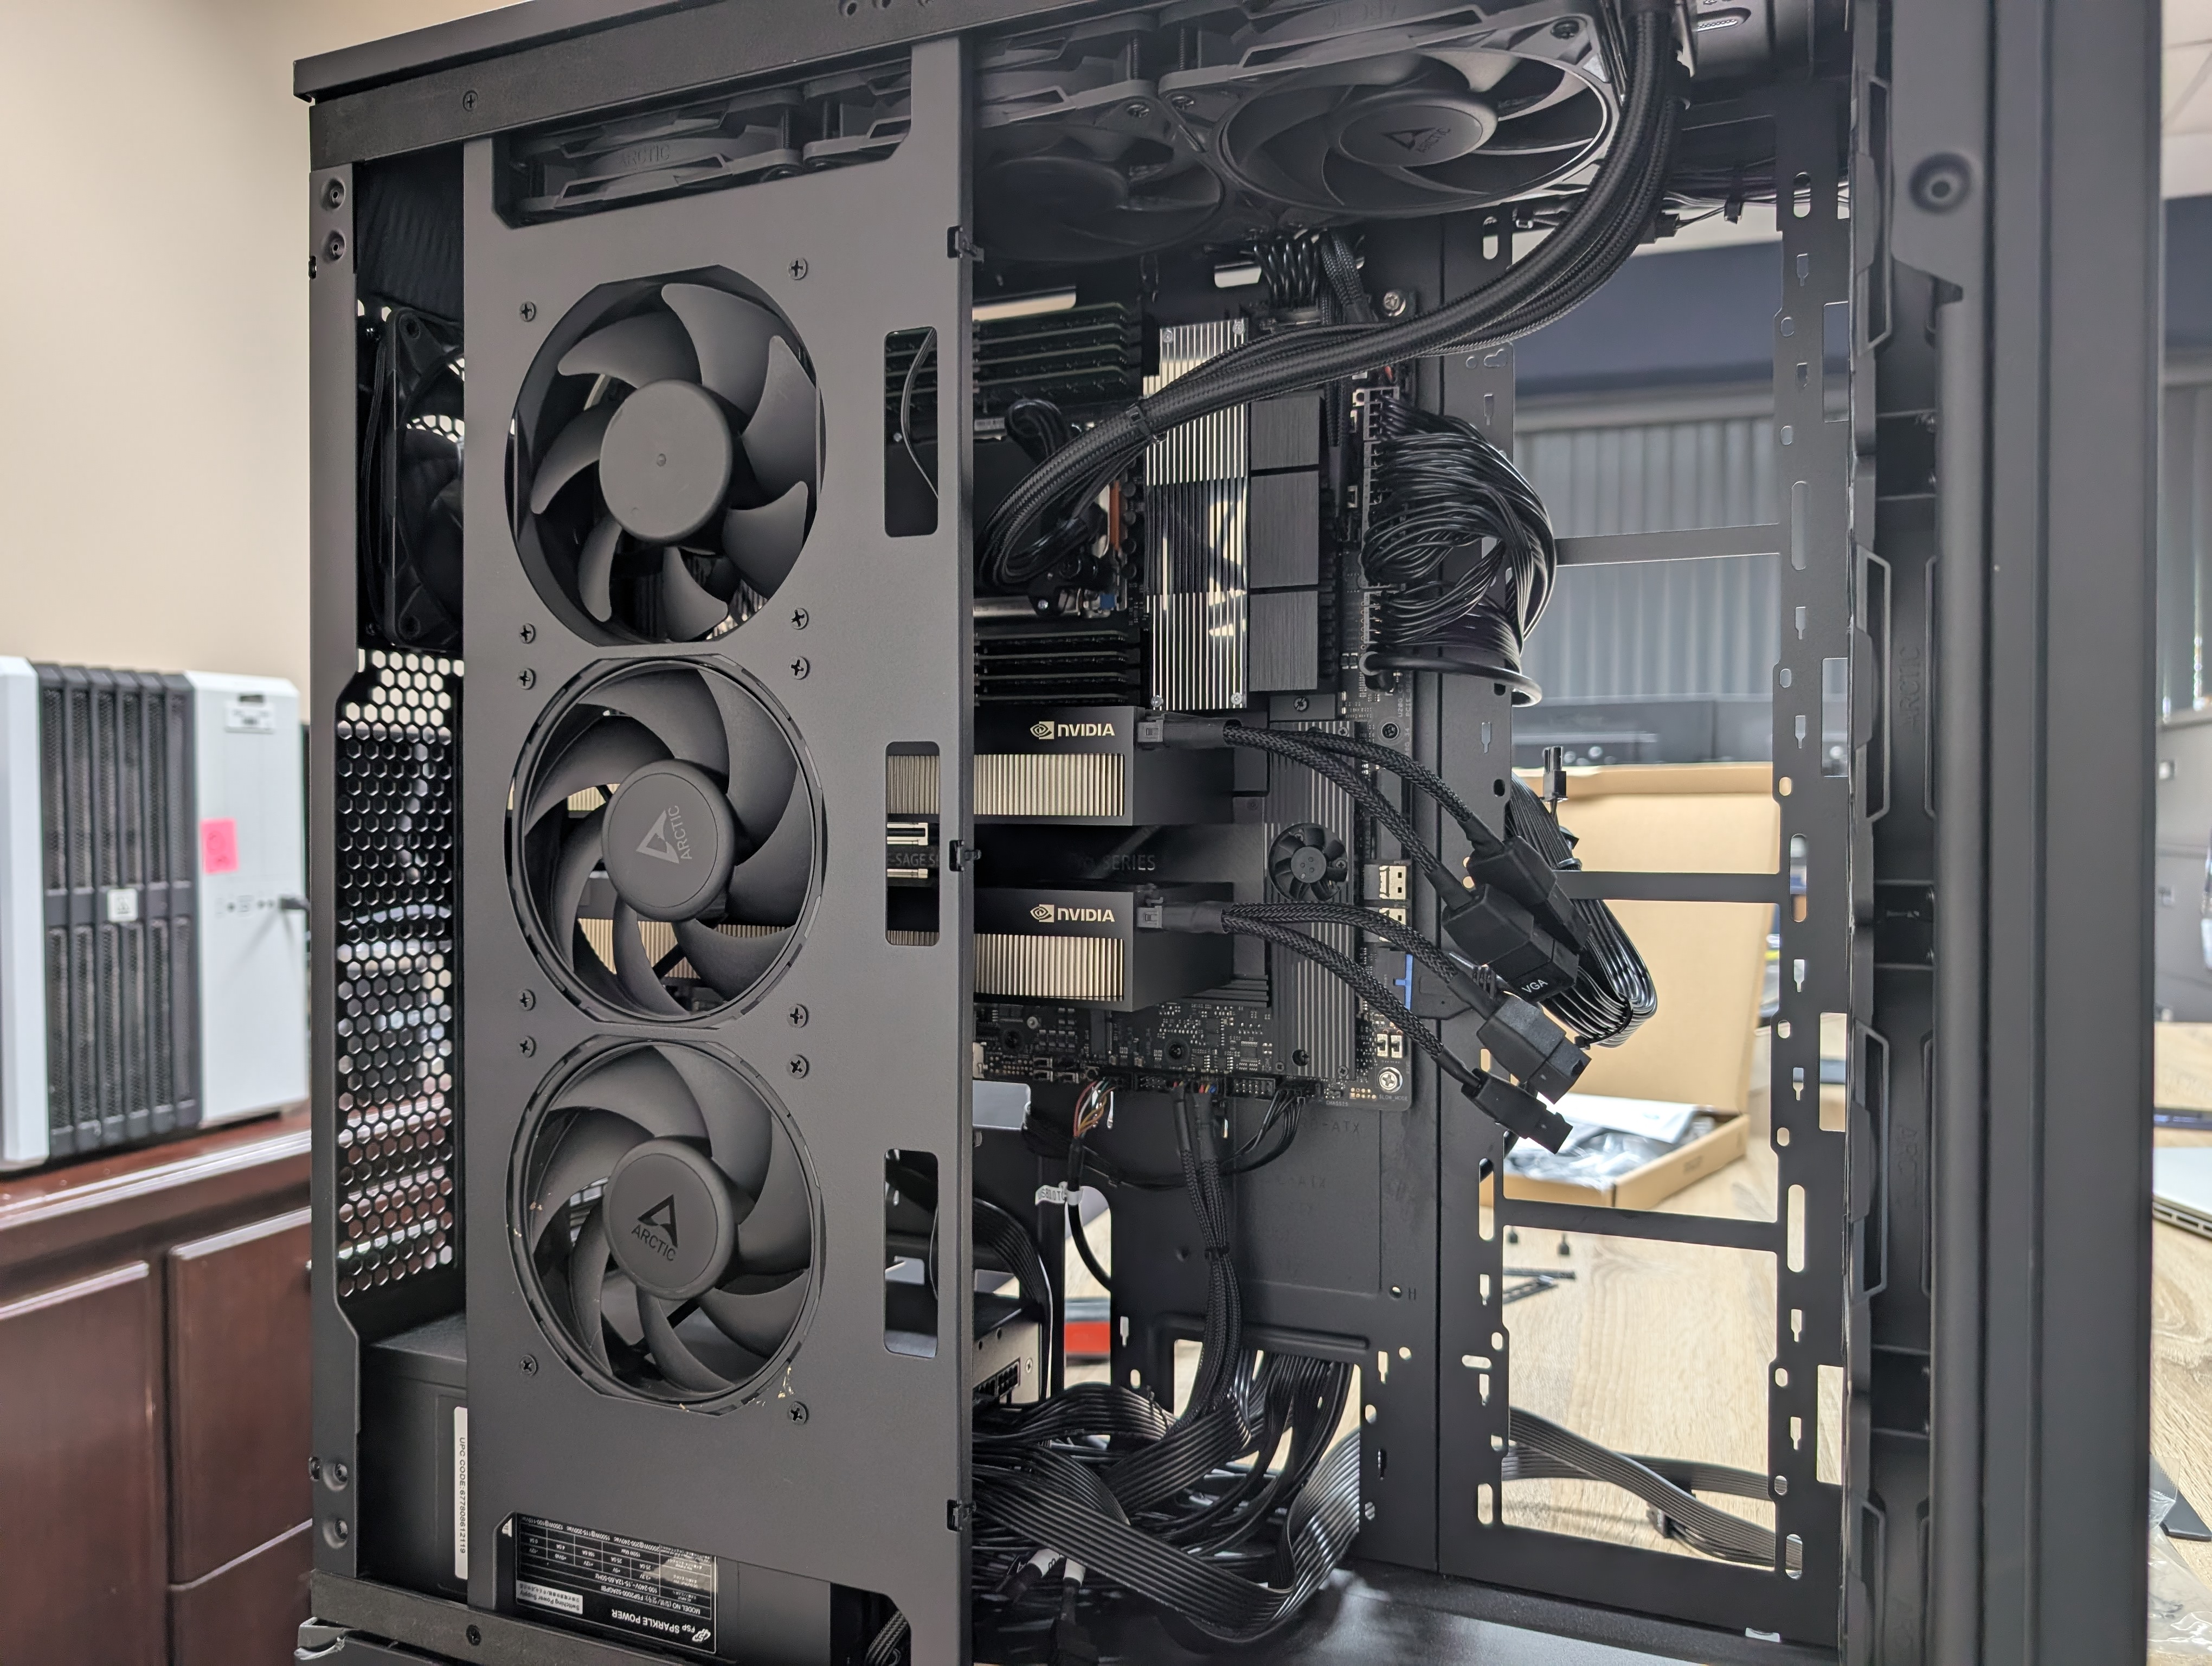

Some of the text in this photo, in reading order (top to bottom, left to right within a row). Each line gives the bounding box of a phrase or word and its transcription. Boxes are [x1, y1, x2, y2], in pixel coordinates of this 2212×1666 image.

[1058, 723, 1115, 736] NVIDIA
[668, 805, 692, 860] ARCTIC
[1103, 854, 1156, 872] SERIES
[1057, 908, 1115, 922] NVIDIA
[1521, 979, 1548, 992] VGA
[631, 1225, 676, 1261] ARCTIC
[538, 1594, 554, 1604] Power
[555, 1598, 580, 1611] Switching
[612, 1609, 641, 1624] POWER
[681, 1605, 700, 1614] MODEL
[642, 1617, 680, 1634] SPARKLE
